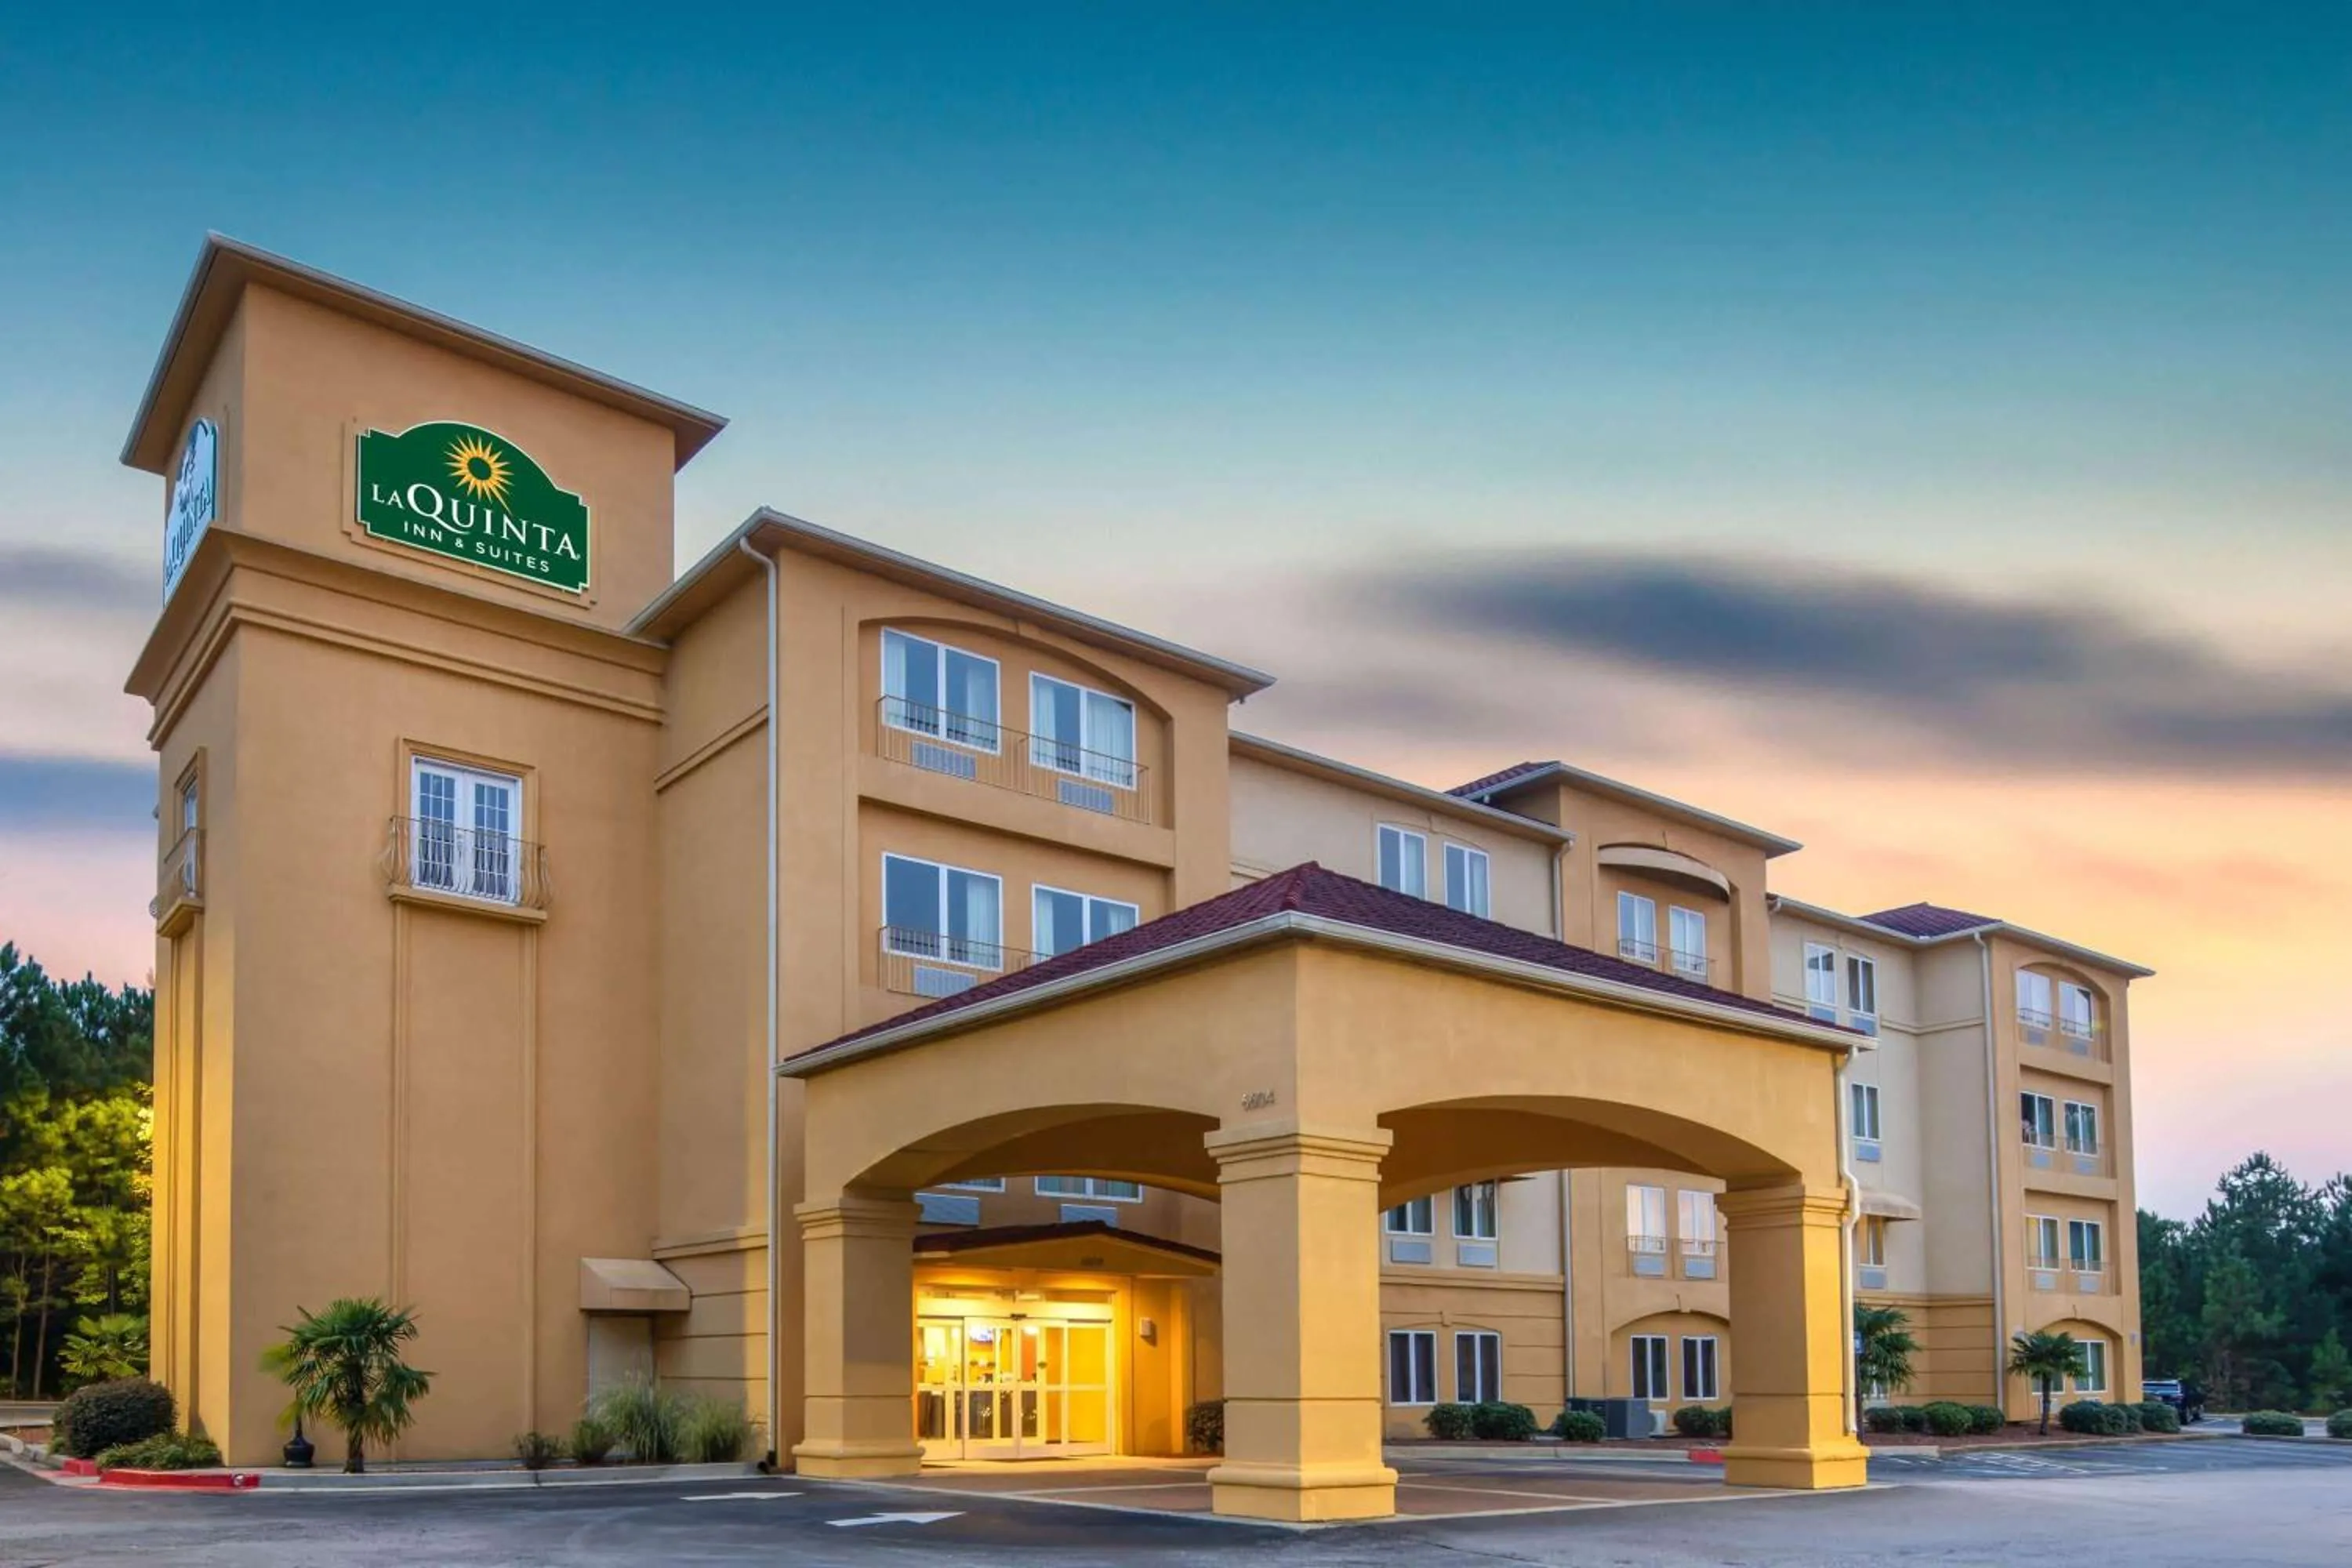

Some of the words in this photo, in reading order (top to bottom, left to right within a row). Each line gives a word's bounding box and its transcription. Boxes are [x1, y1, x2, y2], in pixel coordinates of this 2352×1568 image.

[403, 521, 443, 543] INN
[454, 537, 464, 549] &
[475, 541, 550, 573] SUITES
